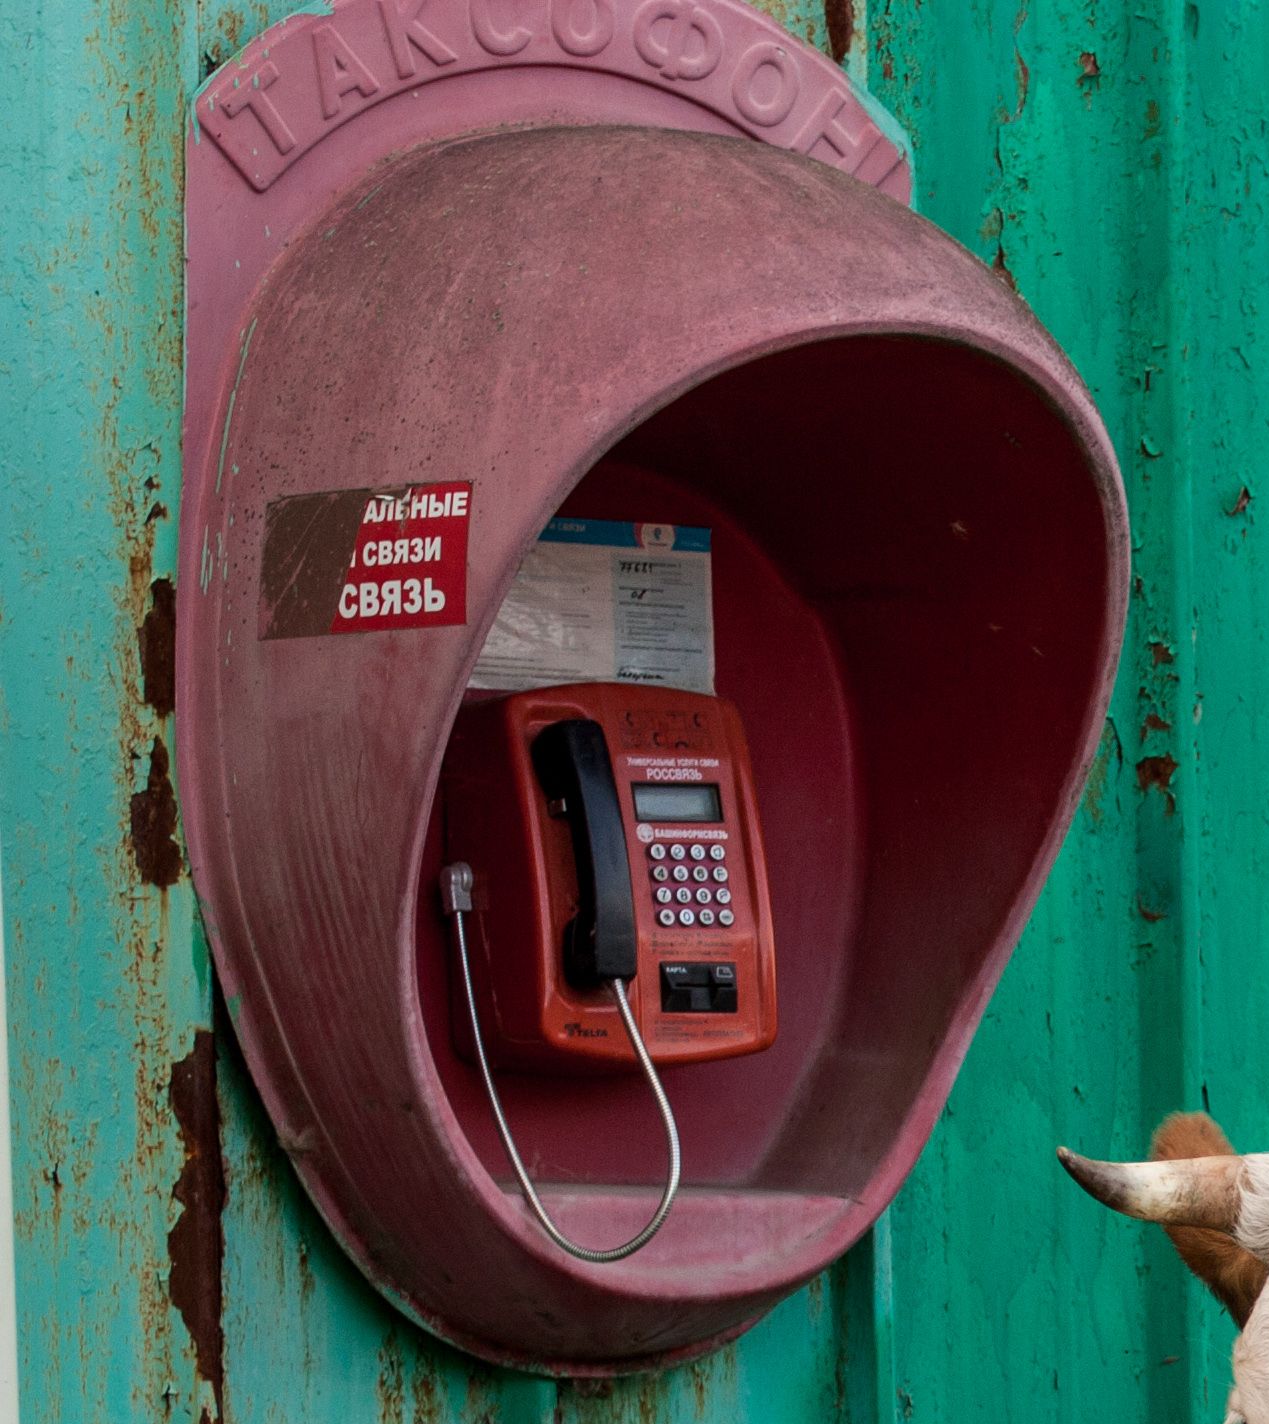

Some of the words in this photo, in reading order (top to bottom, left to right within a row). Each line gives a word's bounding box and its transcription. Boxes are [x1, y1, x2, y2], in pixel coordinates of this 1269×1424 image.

[220, 0, 882, 178] ТАКСОФОН
[362, 536, 442, 566] СВЯЗИ
[338, 577, 446, 619] СВЯЗЬ
[646, 768, 702, 780] РОССВЯЗЬ
[674, 847, 682, 857] 2
[694, 847, 702, 857] 3
[657, 868, 665, 878] 4
[677, 869, 685, 879] 5
[680, 890, 688, 901] 8
[700, 890, 708, 901] 9
